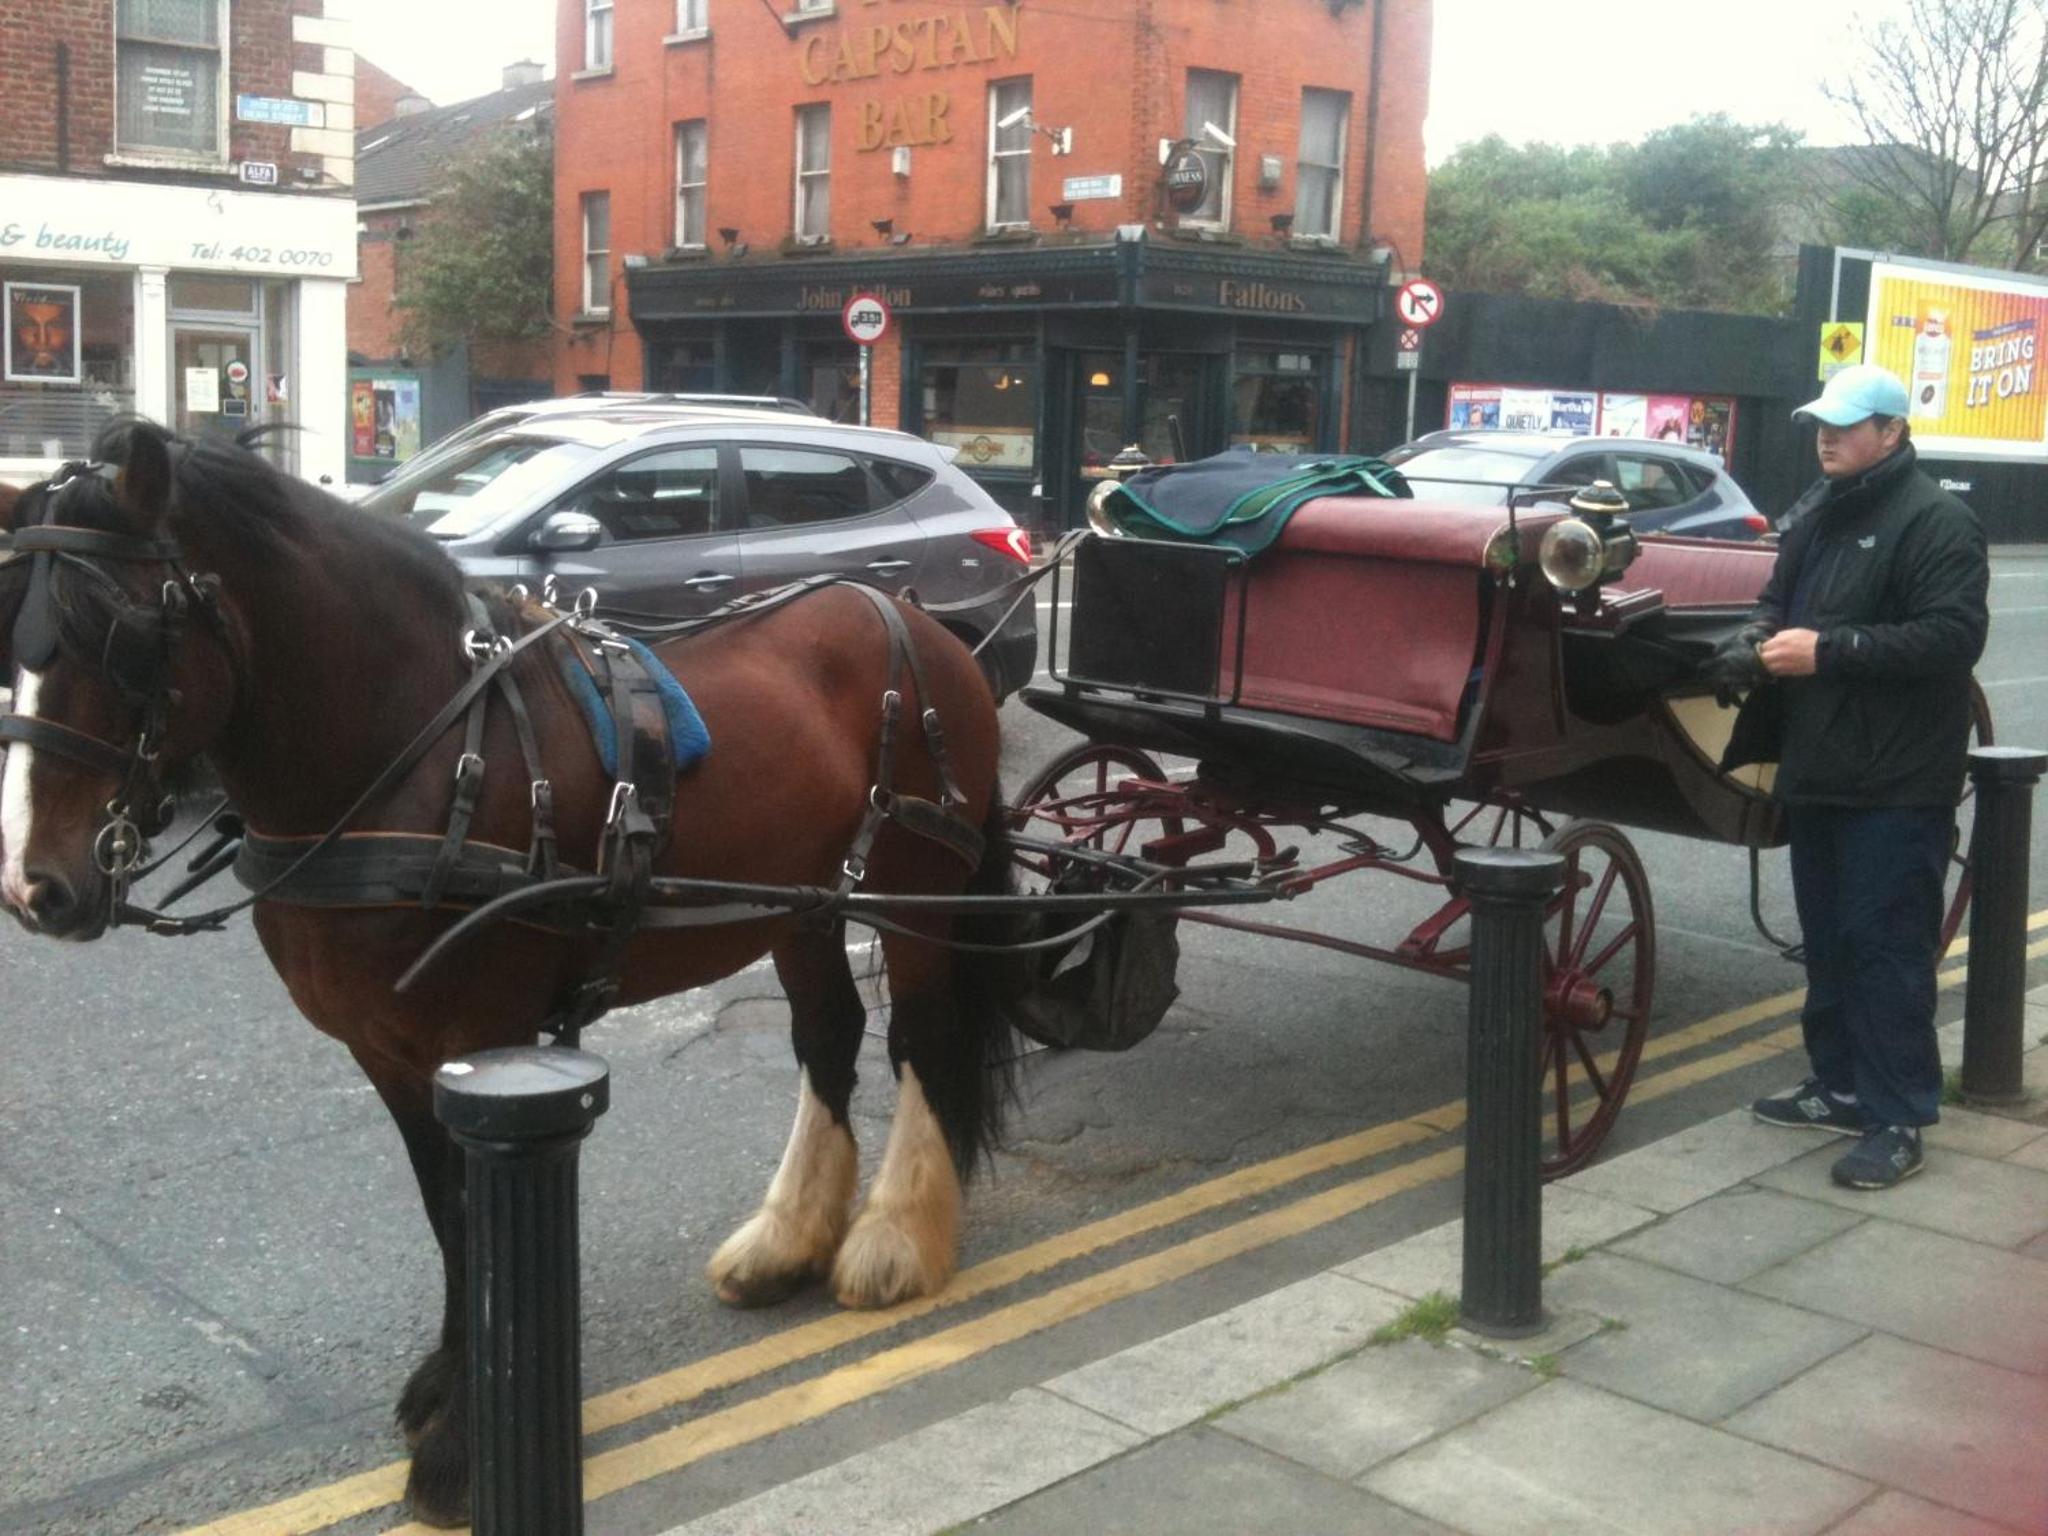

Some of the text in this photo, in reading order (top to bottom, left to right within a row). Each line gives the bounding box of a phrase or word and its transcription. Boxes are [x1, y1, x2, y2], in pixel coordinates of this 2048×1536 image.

[802, 3, 1020, 87] CAPSTAN
[856, 93, 954, 153] BAR
[0, 222, 130, 261] & beauty
[191, 241, 333, 267] Tel: 402 0070
[795, 283, 912, 311] John Fllon
[1219, 280, 1306, 311] Fallons
[1969, 335, 2034, 372] BRING
[1966, 364, 2032, 407] IT ON
